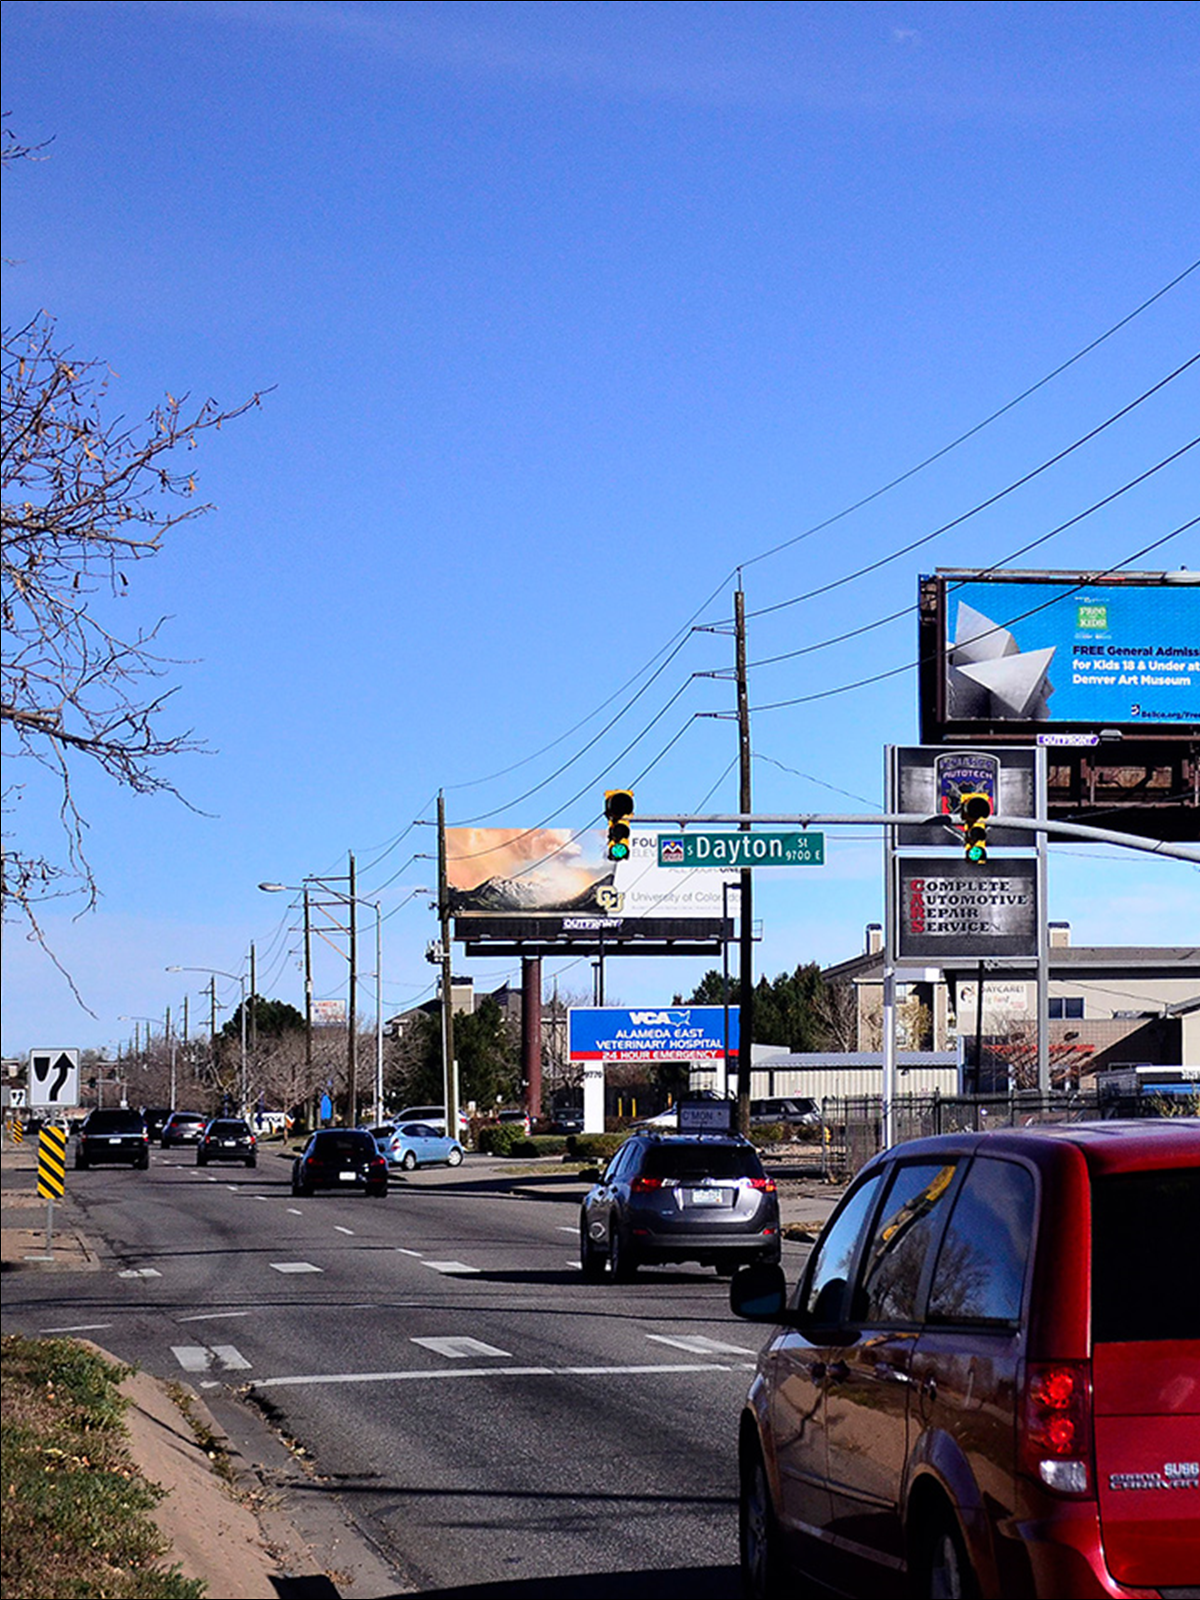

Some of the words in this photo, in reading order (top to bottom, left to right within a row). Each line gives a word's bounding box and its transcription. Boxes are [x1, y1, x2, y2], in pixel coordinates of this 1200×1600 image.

[1072, 645, 1105, 656] FREE
[1107, 645, 1153, 657] General
[1072, 659, 1091, 670] for
[1093, 659, 1120, 671] Kids
[1123, 660, 1135, 671] 18
[1137, 660, 1146, 671] &
[1149, 660, 1185, 672] Under
[1187, 661, 1200, 672] at
[1072, 674, 1117, 685] Denver
[1118, 675, 1139, 686] Art
[1141, 674, 1191, 686] Museum
[943, 769, 993, 779] AUTOTECH
[632, 837, 657, 848] FOU
[697, 836, 782, 864] Dayton
[797, 838, 808, 848] St
[785, 849, 811, 861] 9700
[815, 850, 821, 860] E
[910, 879, 1010, 892] COMPLETE
[694, 891, 740, 902] Colordo
[910, 893, 1027, 906] AUTOMOTIVE
[910, 906, 979, 919] REPAIR
[910, 919, 990, 933] SERVICE
[629, 1011, 670, 1025] VCA
[615, 1030, 671, 1038] ALAMEDA
[674, 1028, 704, 1038] EAST
[595, 1040, 666, 1050] VETERINARY
[669, 1039, 723, 1049] HOSPITAL
[602, 1052, 617, 1060] 24
[620, 1051, 650, 1060] HOUR
[652, 1050, 718, 1060] EMERGENCY
